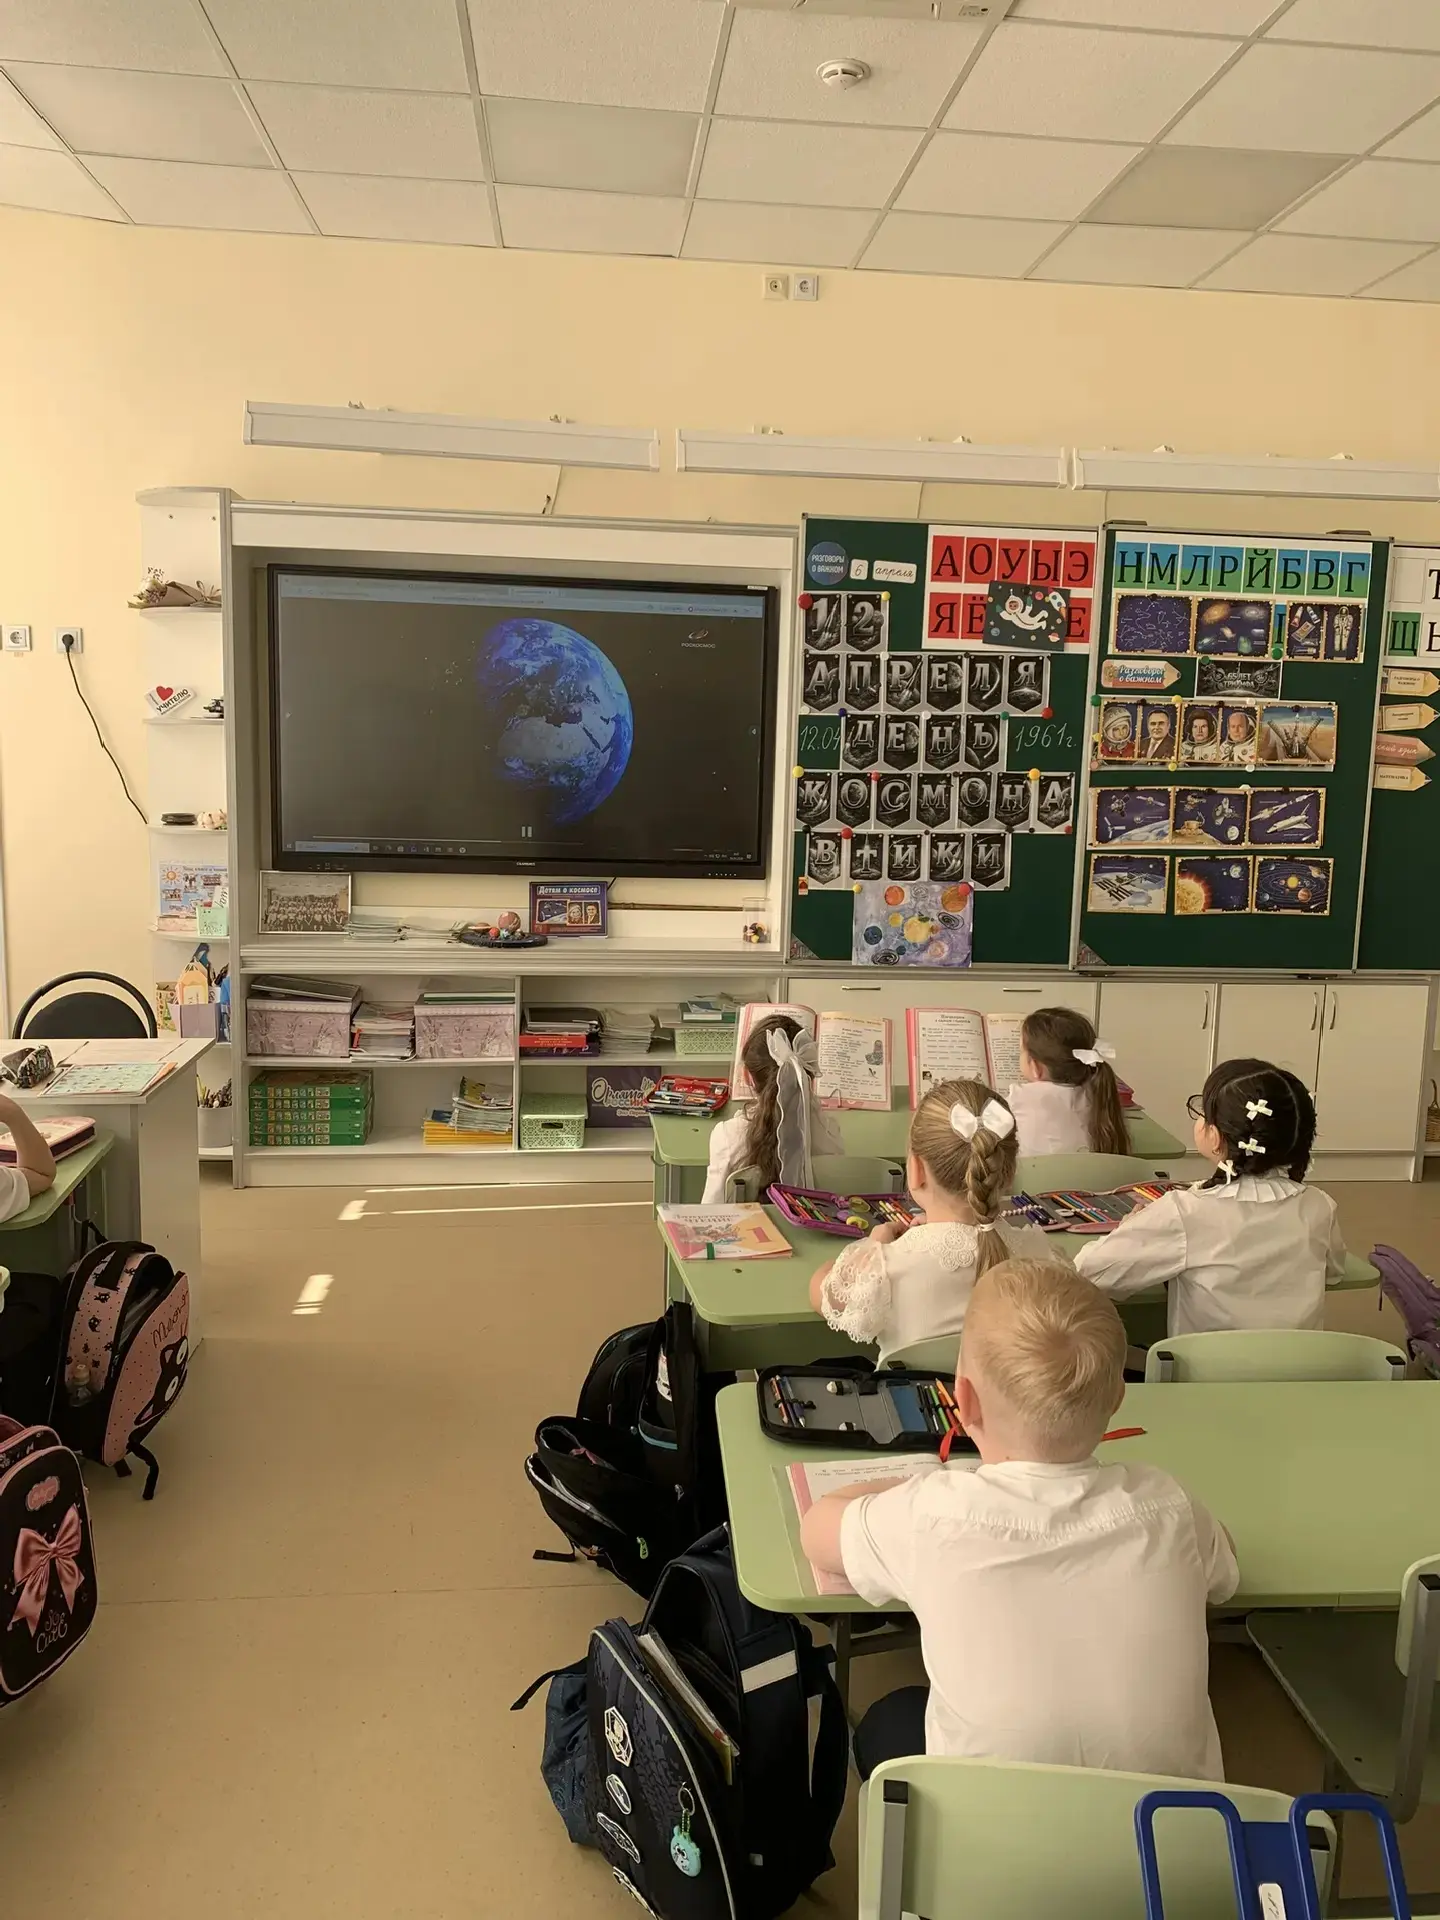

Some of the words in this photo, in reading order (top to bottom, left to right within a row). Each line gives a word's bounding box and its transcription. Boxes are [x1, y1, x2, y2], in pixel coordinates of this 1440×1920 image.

[811, 554, 845, 563] РАЗГОВОРЫ
[817, 565, 844, 573] ВАЖНОМ
[854, 564, 864, 577] 6
[874, 566, 914, 581] апреля
[811, 597, 876, 637] 12
[806, 660, 1036, 695] АПРЕЛЯ
[1119, 665, 1164, 677] Разговоры
[156, 688, 189, 712] УЧИТЕЛЮ
[852, 720, 994, 759] ДЕНЬ
[802, 778, 1067, 811] КОСМОНА
[815, 839, 1004, 874] ВТИКИ
[538, 885, 561, 894] Детям
[592, 1078, 644, 1103] Орлята
